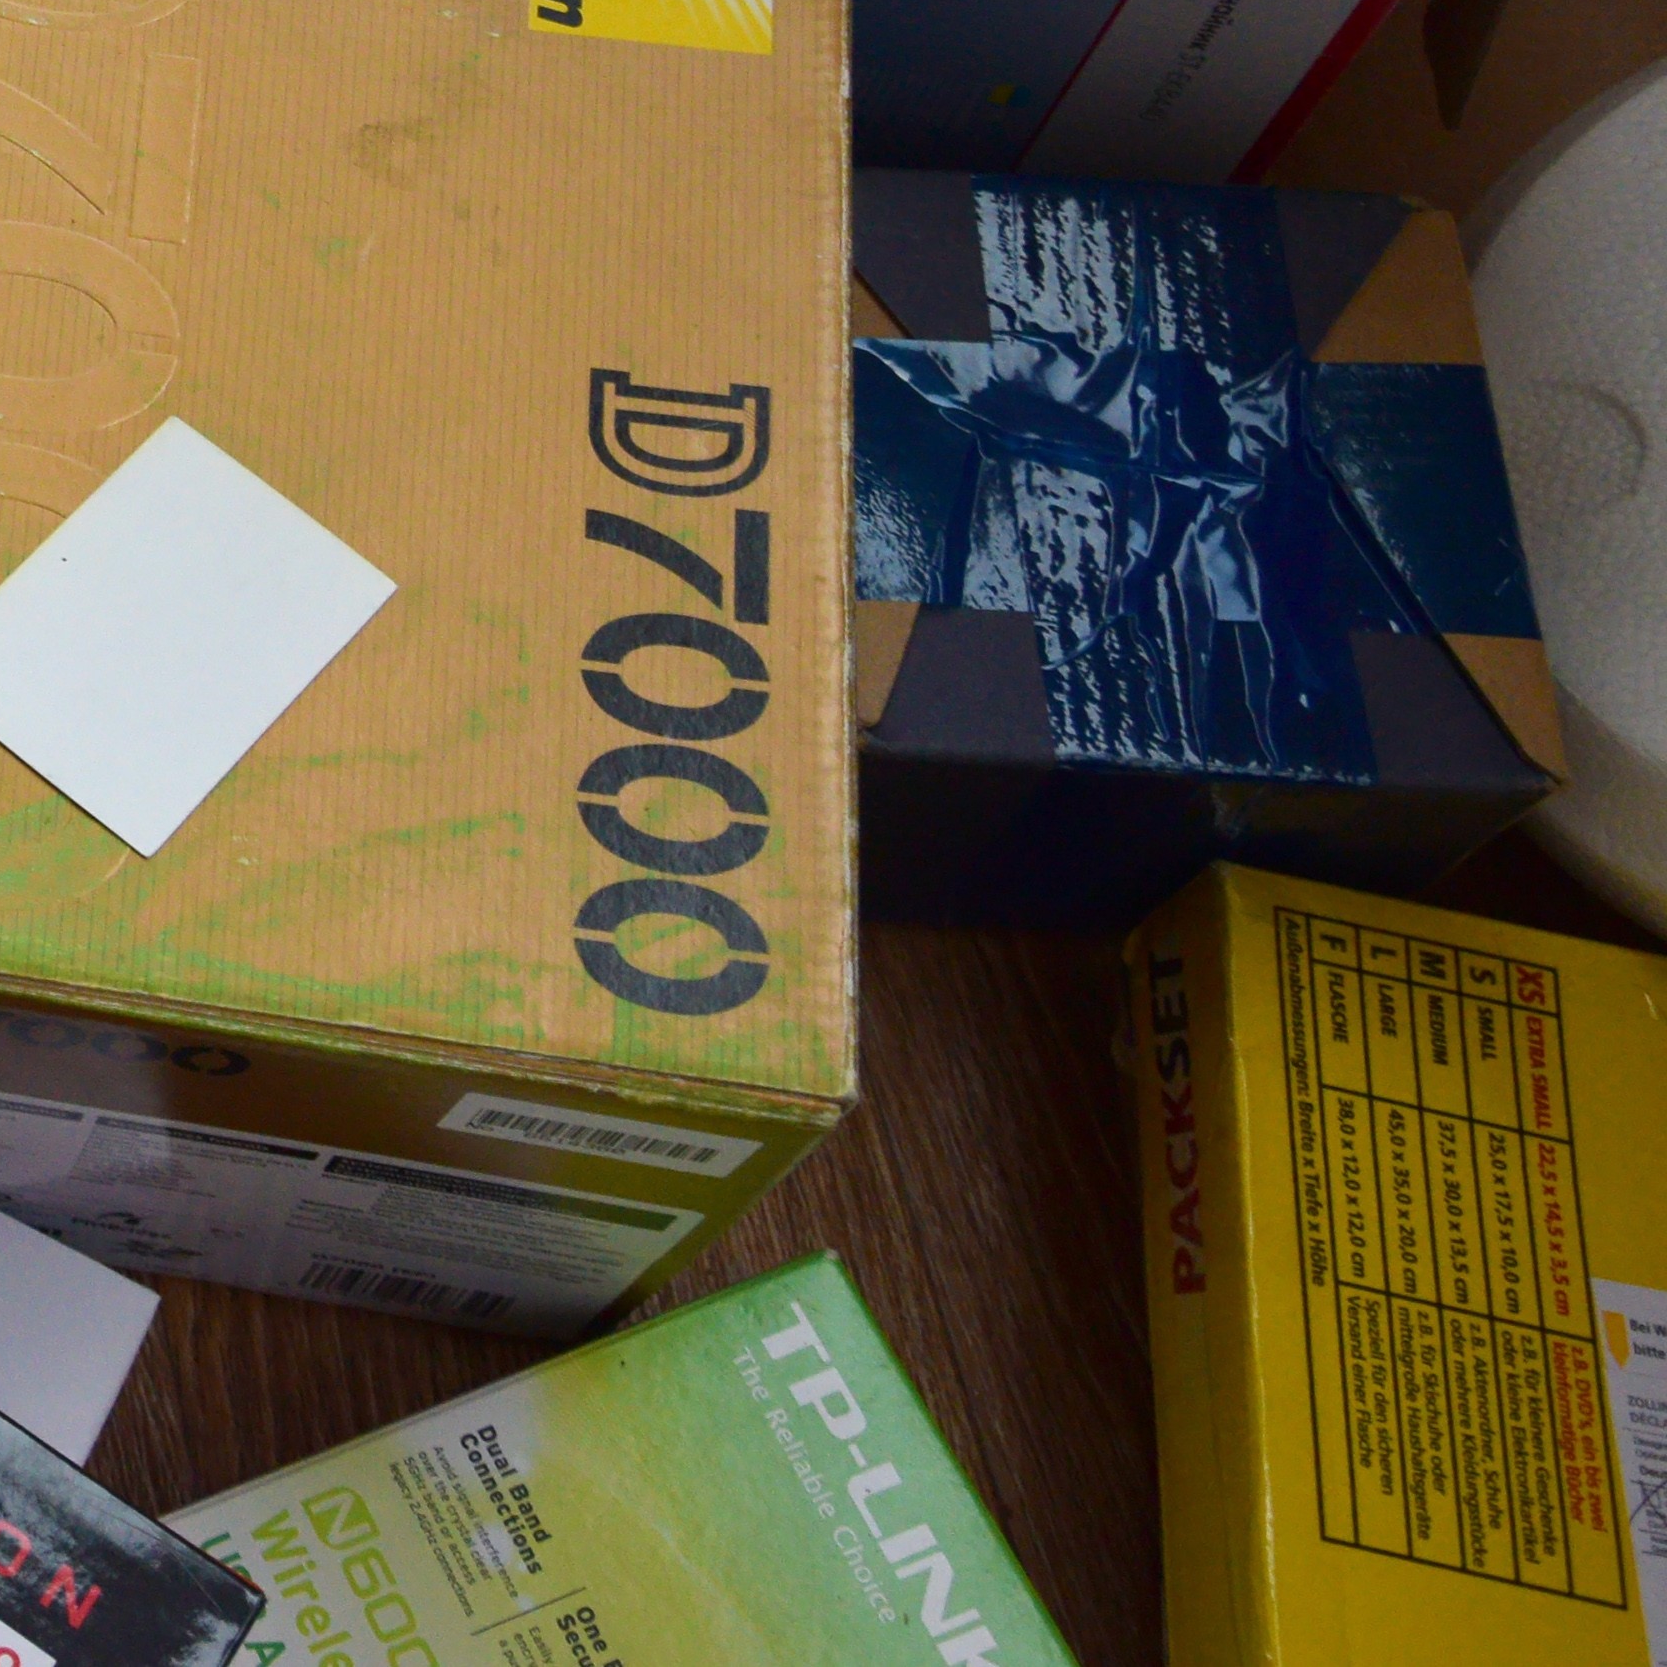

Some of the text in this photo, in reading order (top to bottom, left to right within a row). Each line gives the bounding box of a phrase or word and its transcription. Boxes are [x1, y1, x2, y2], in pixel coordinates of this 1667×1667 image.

[574, 370, 775, 1019] D7000
[1328, 971, 1349, 1045] FLASCHE
[1377, 983, 1398, 1039] LARGE
[1418, 949, 1449, 1066] M MEDIUM
[1150, 946, 1207, 1296] PACKSET
[459, 1428, 543, 1575] Connections
[474, 1423, 552, 1543] Dual Band
[732, 1347, 895, 1624] The Reliable Choice
